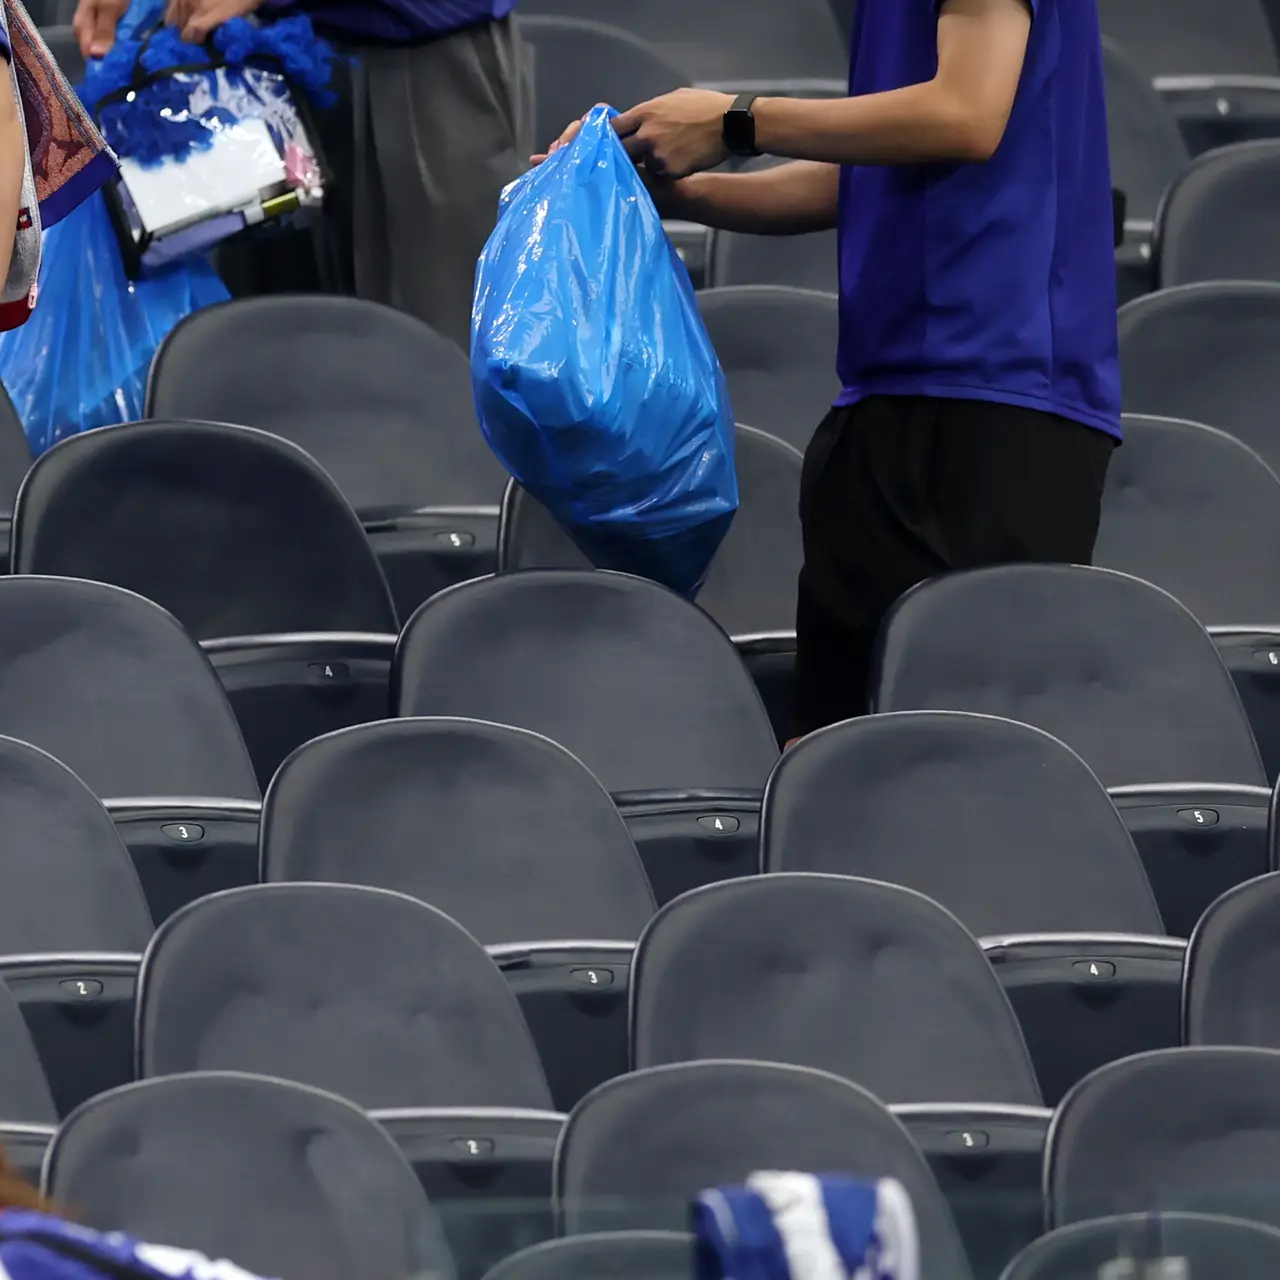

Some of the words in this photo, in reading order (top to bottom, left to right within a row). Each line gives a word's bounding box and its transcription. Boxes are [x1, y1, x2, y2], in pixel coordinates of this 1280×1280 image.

[325, 665, 333, 678] 4
[1193, 810, 1204, 823] 5
[714, 818, 723, 830] 4
[178, 826, 189, 839] 3
[1090, 963, 1099, 976] 4
[587, 971, 598, 984] 3
[76, 981, 88, 995] 2
